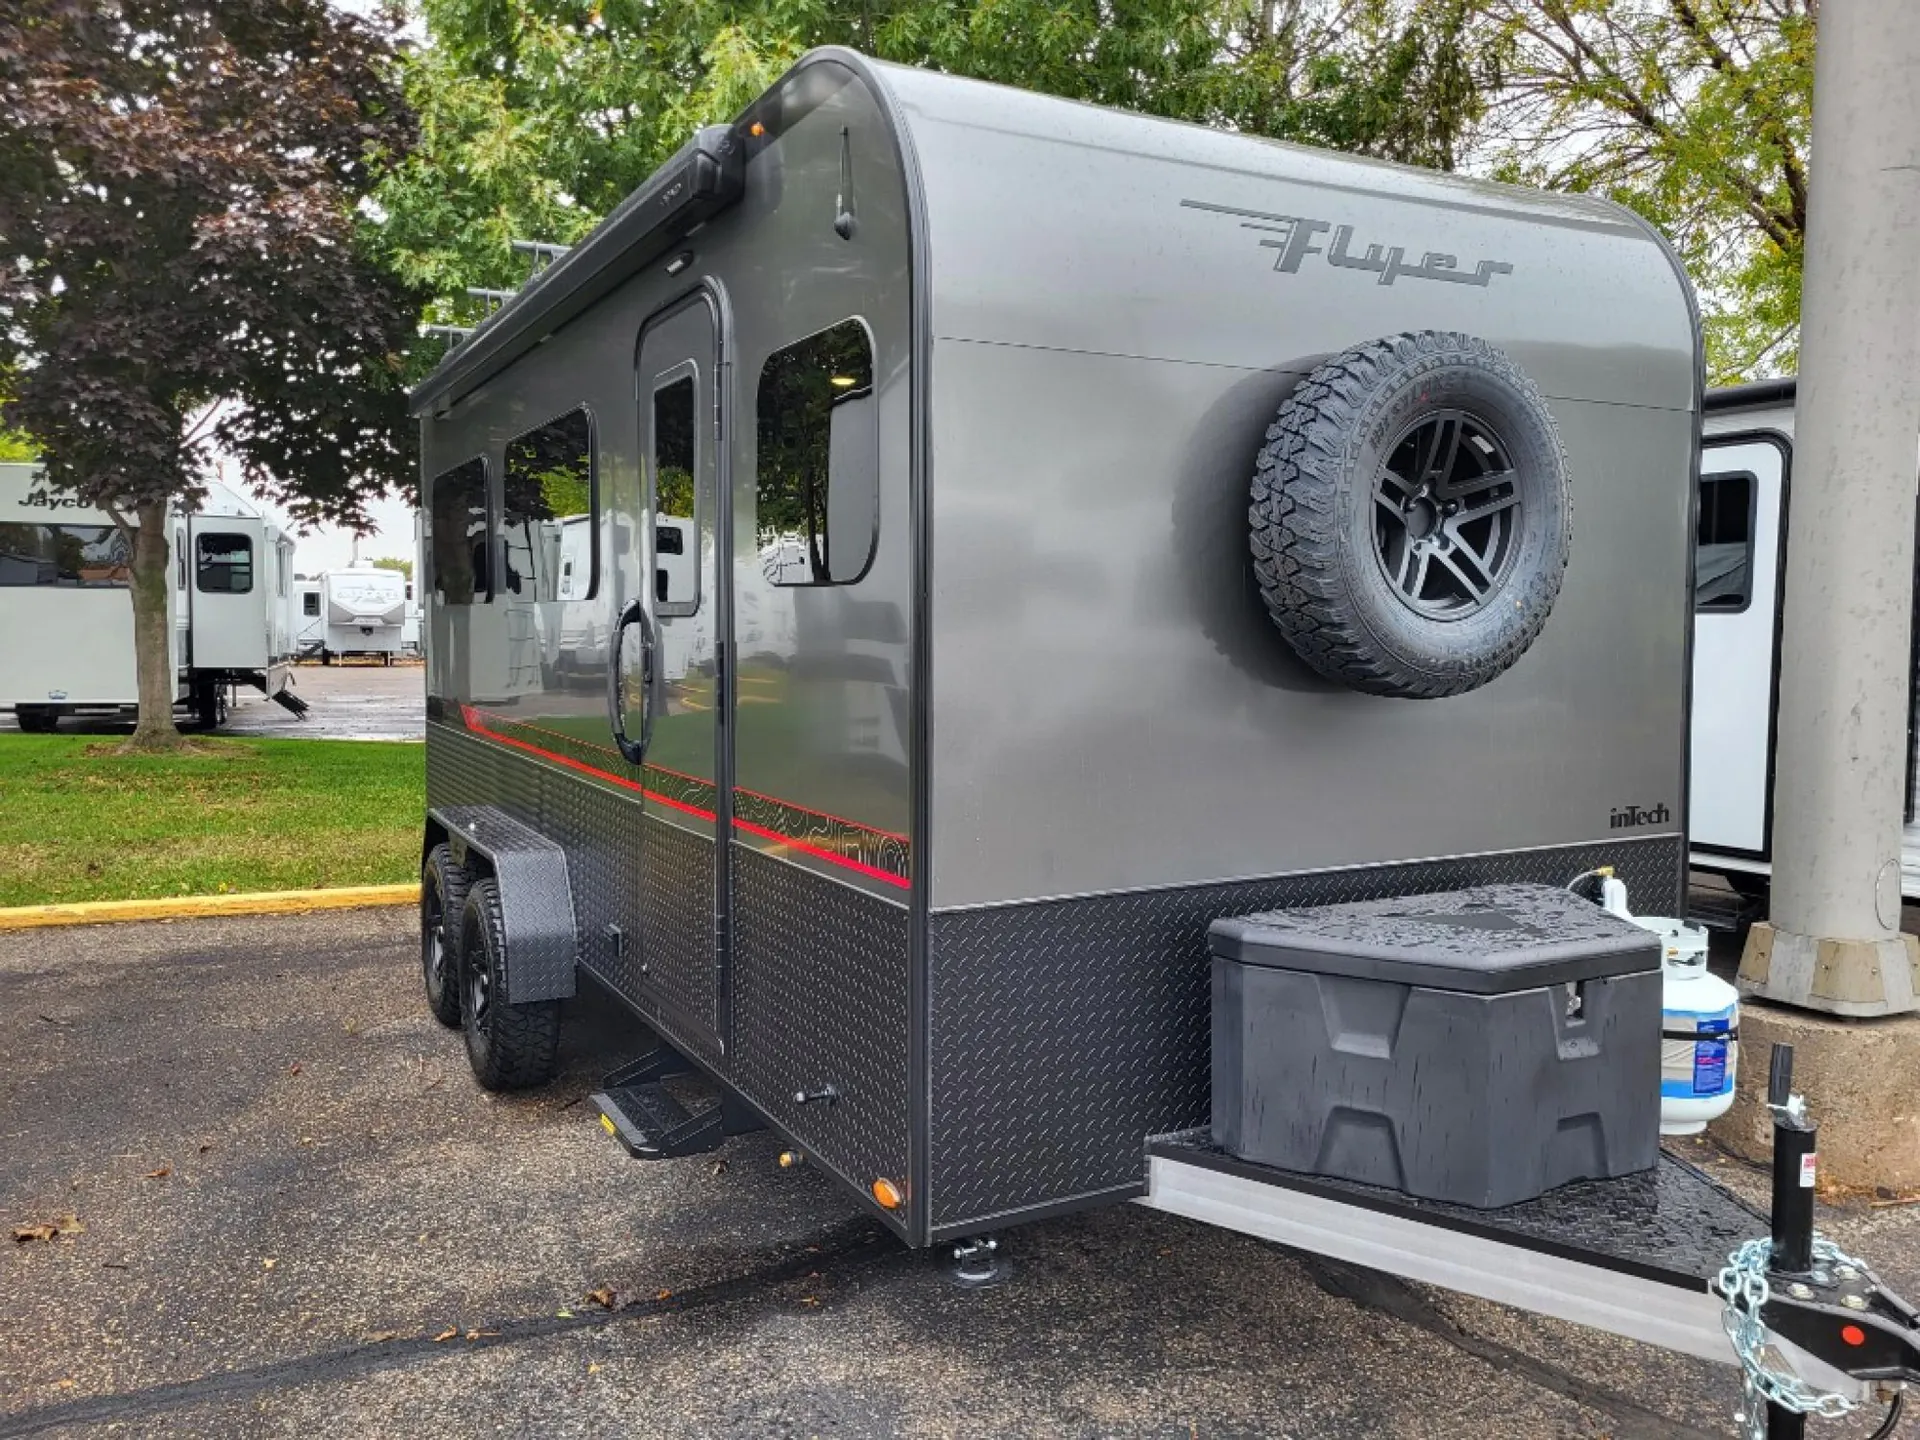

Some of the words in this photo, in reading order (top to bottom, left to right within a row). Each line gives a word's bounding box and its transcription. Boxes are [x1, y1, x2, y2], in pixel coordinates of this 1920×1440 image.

[1179, 199, 1514, 286] Flyer
[18, 493, 91, 510] Jayco
[1610, 802, 1670, 829] inTech
